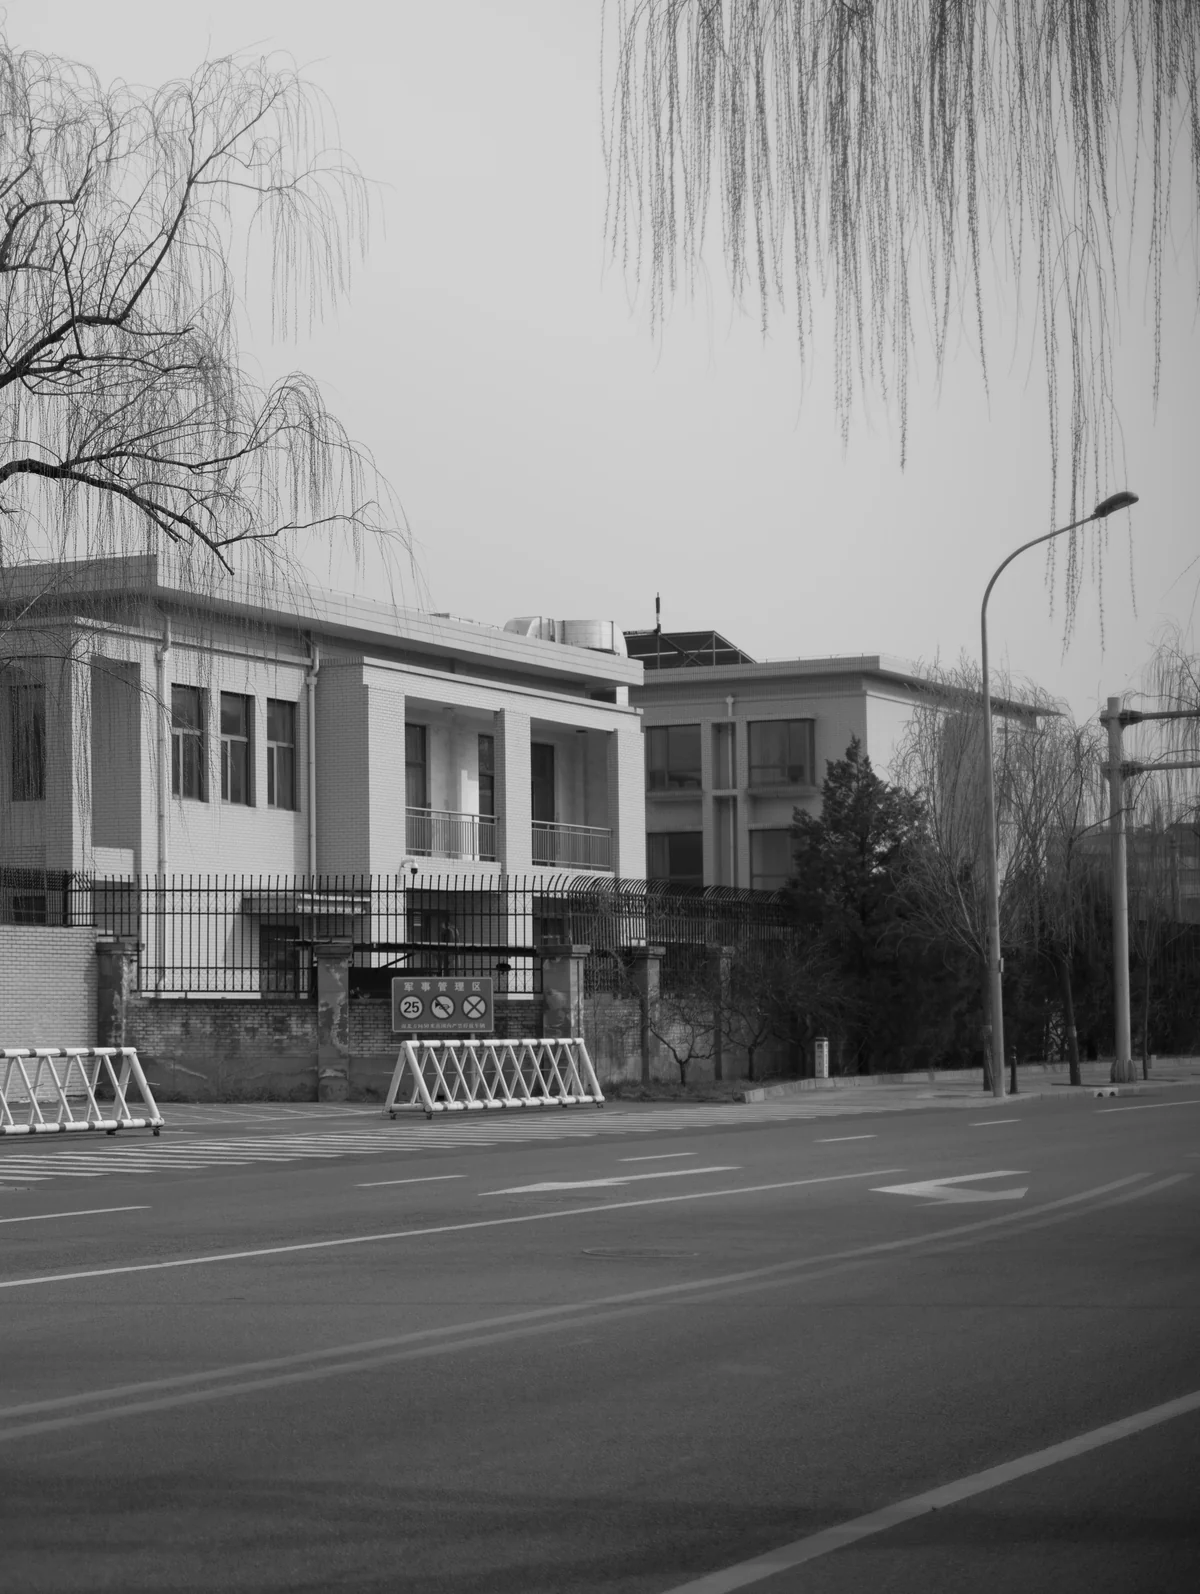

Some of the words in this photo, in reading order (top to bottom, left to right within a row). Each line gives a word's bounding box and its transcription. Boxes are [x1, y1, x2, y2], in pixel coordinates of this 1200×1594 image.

[404, 981, 481, 992] 军事管理区
[404, 1001, 420, 1013] 25
